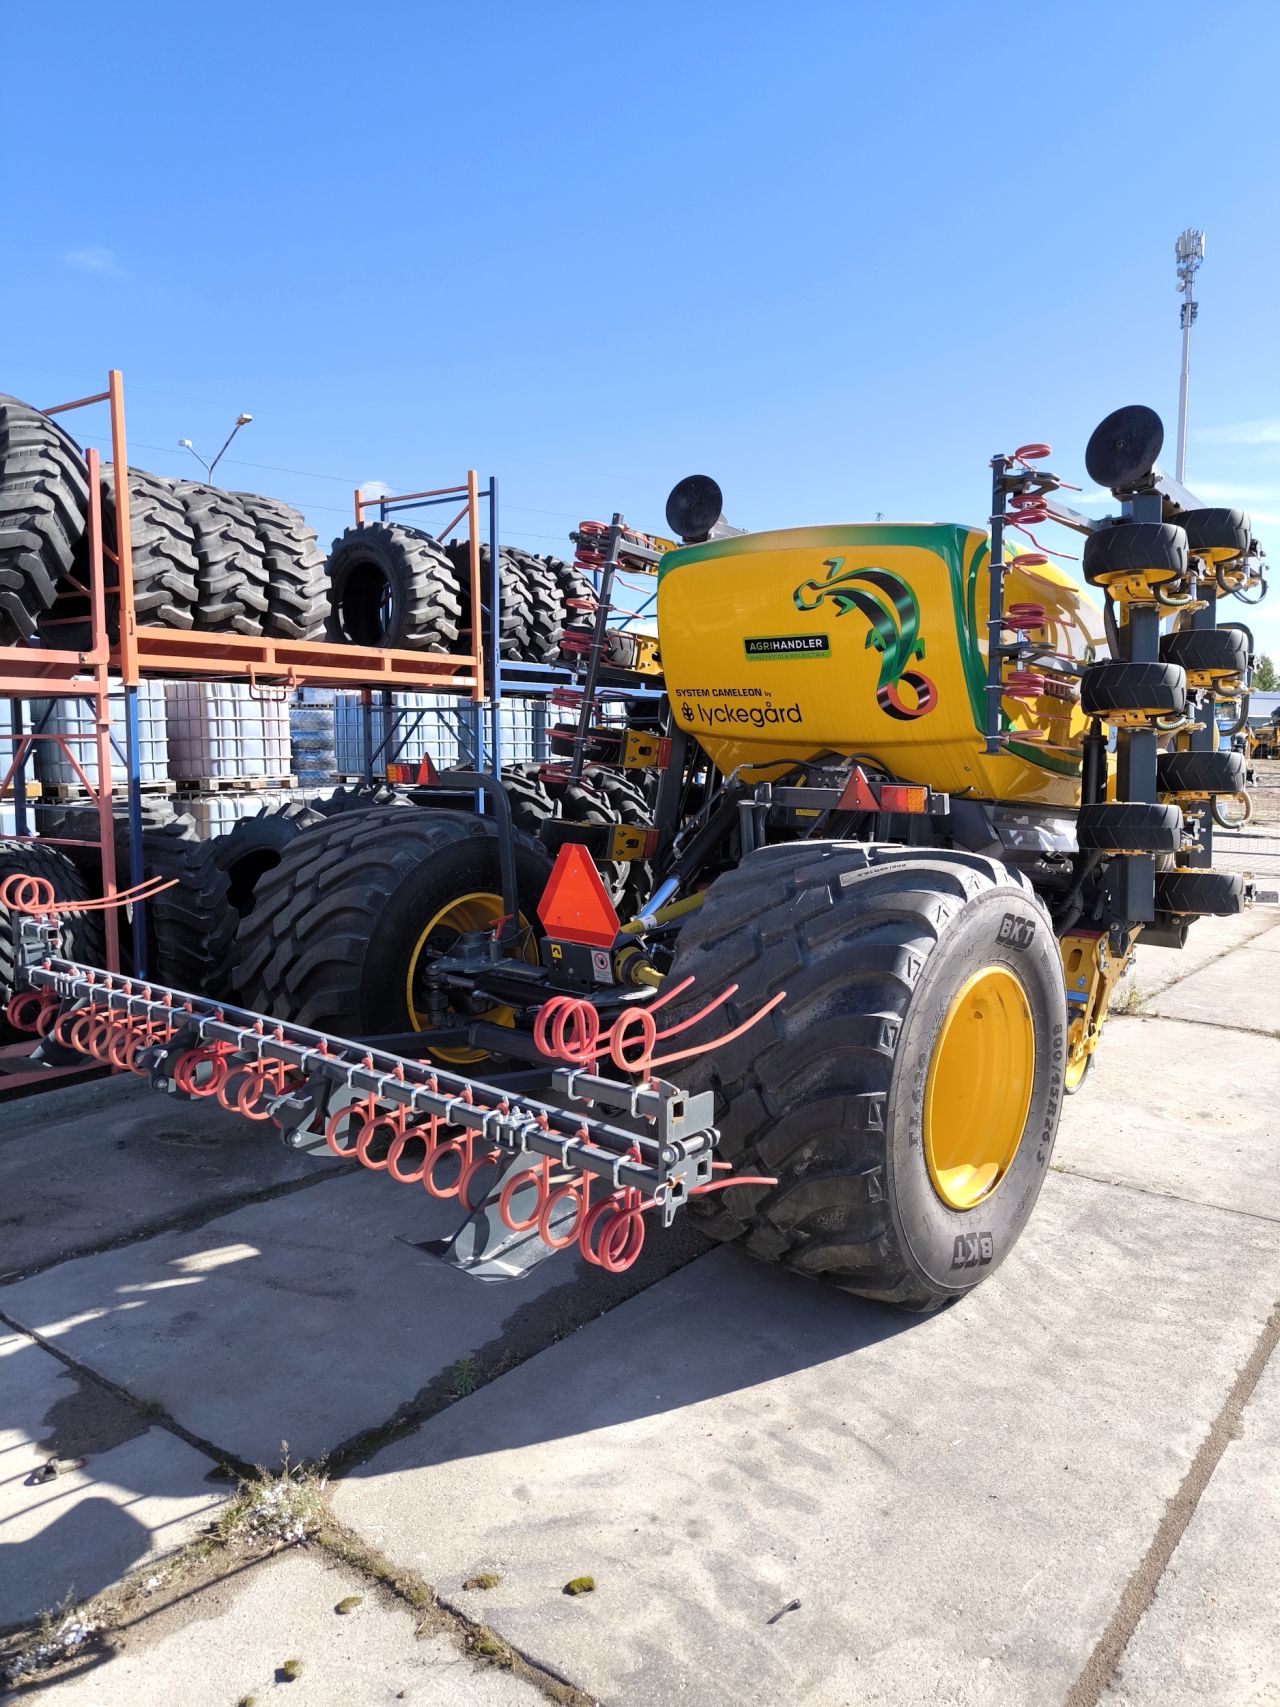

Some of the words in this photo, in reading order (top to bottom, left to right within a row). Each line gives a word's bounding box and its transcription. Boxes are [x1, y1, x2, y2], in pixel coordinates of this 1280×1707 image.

[749, 638, 824, 651] AGRIHANDLER
[675, 688, 711, 697] SYSTEM
[712, 688, 763, 697] CAMELEON
[764, 690, 772, 698] by
[696, 701, 803, 728] lyckegård
[999, 916, 1035, 946] BKT
[953, 1236, 993, 1266] BKT
